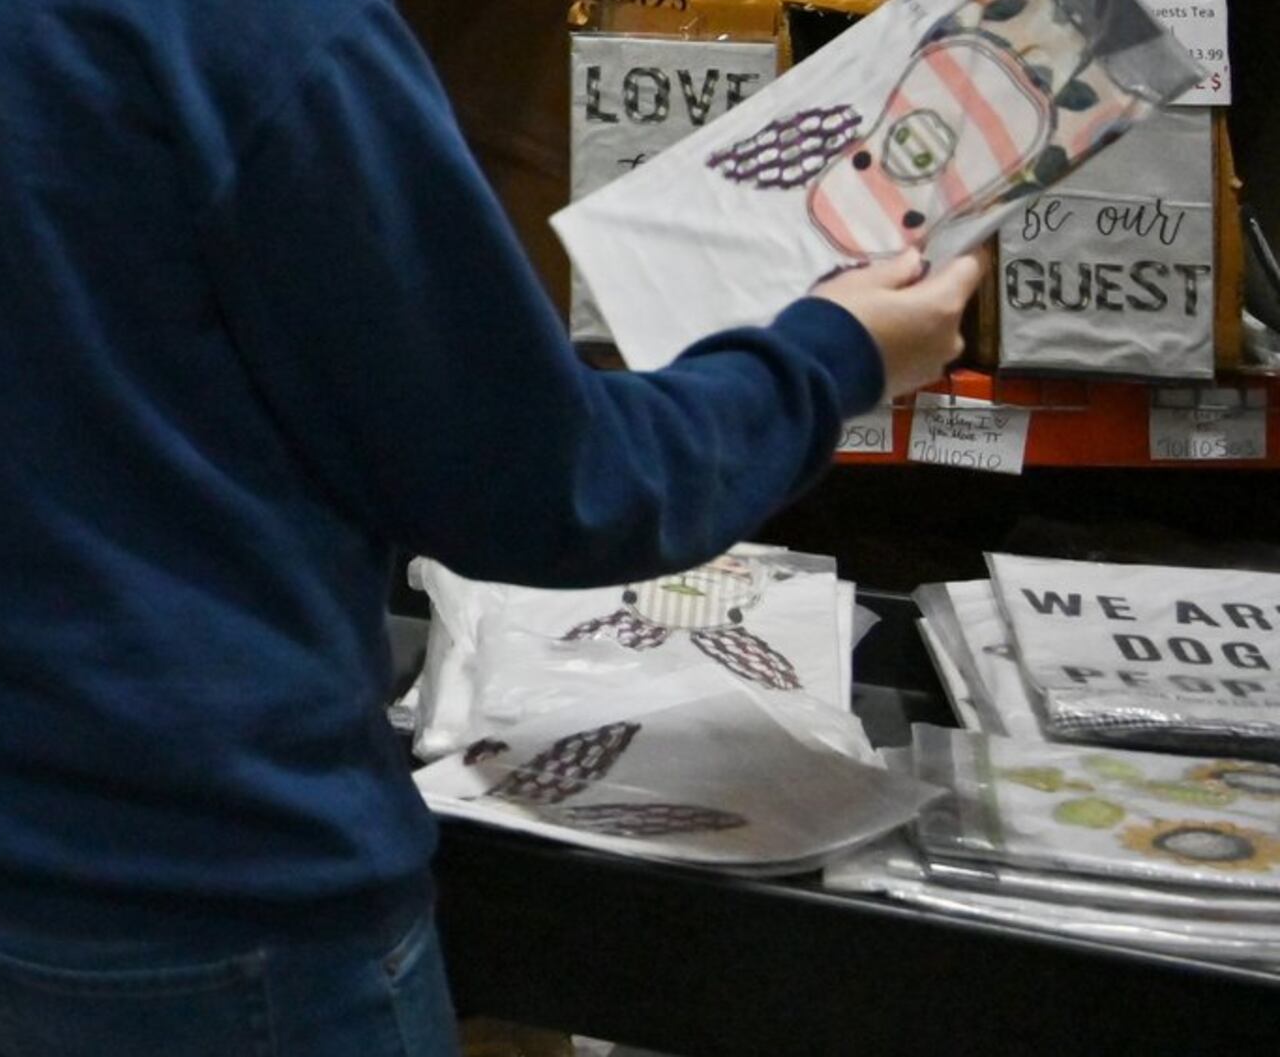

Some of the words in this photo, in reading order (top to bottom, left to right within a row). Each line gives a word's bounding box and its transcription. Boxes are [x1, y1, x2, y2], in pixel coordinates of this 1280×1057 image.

[1191, 6, 1215, 18] Tea
[1097, 198, 1186, 245] our
[1005, 258, 1212, 317] GUEST
[1020, 588, 1137, 622] WE
[1175, 600, 1280, 632] AR
[1112, 633, 1271, 672] DOG
